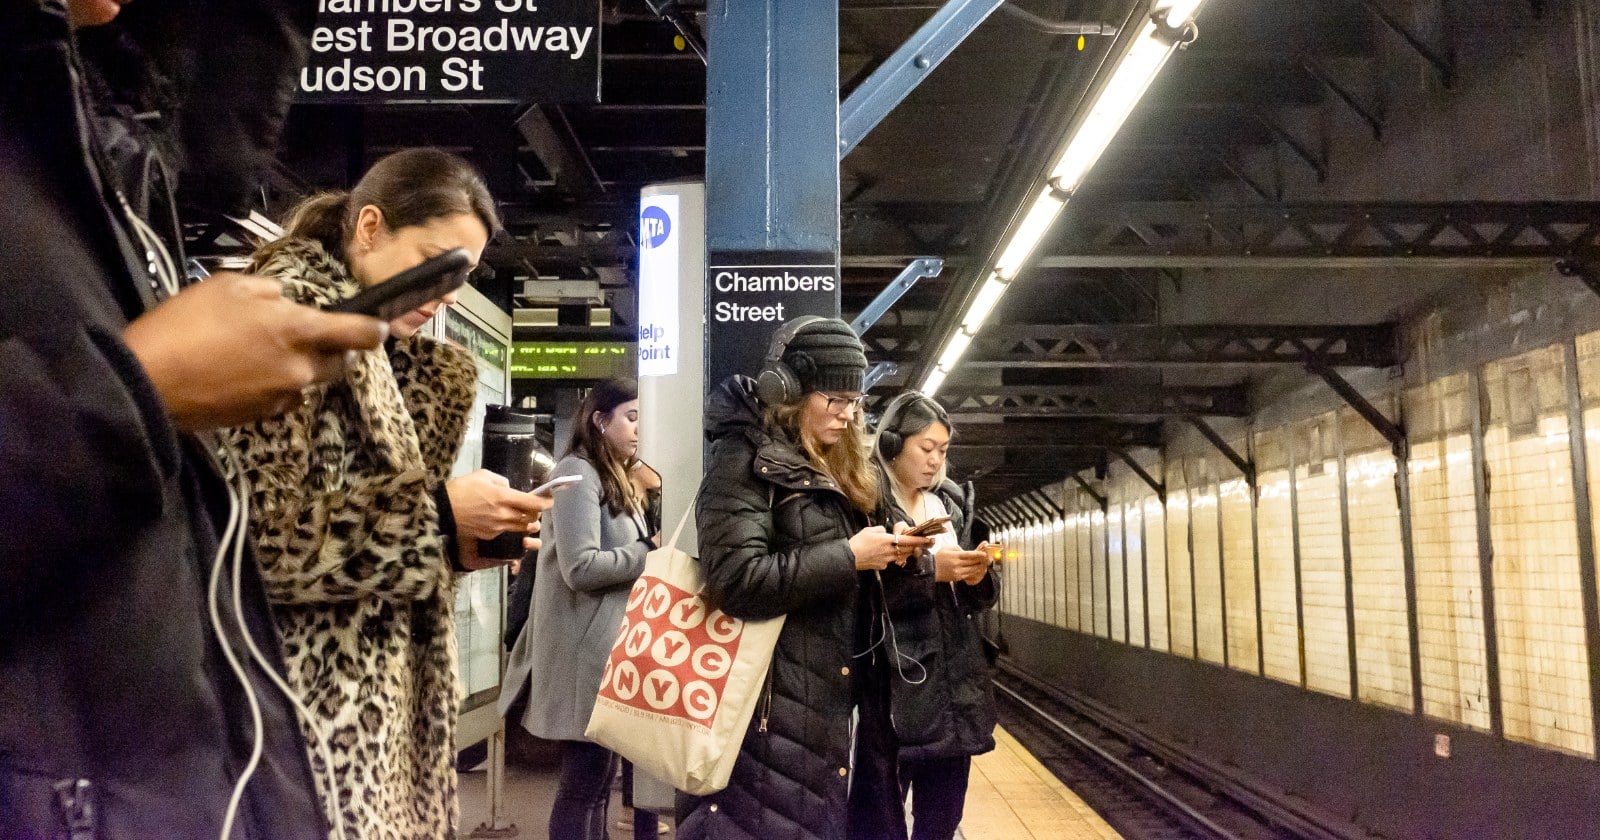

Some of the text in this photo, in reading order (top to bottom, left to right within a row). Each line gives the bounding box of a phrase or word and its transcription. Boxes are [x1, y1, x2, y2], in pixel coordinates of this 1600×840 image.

[312, 19, 593, 60] est Broadway
[300, 57, 484, 92] udson St
[715, 272, 835, 292] Chambers
[715, 302, 785, 322] Street
[620, 625, 723, 672] NYC
[602, 664, 710, 712] NYC
